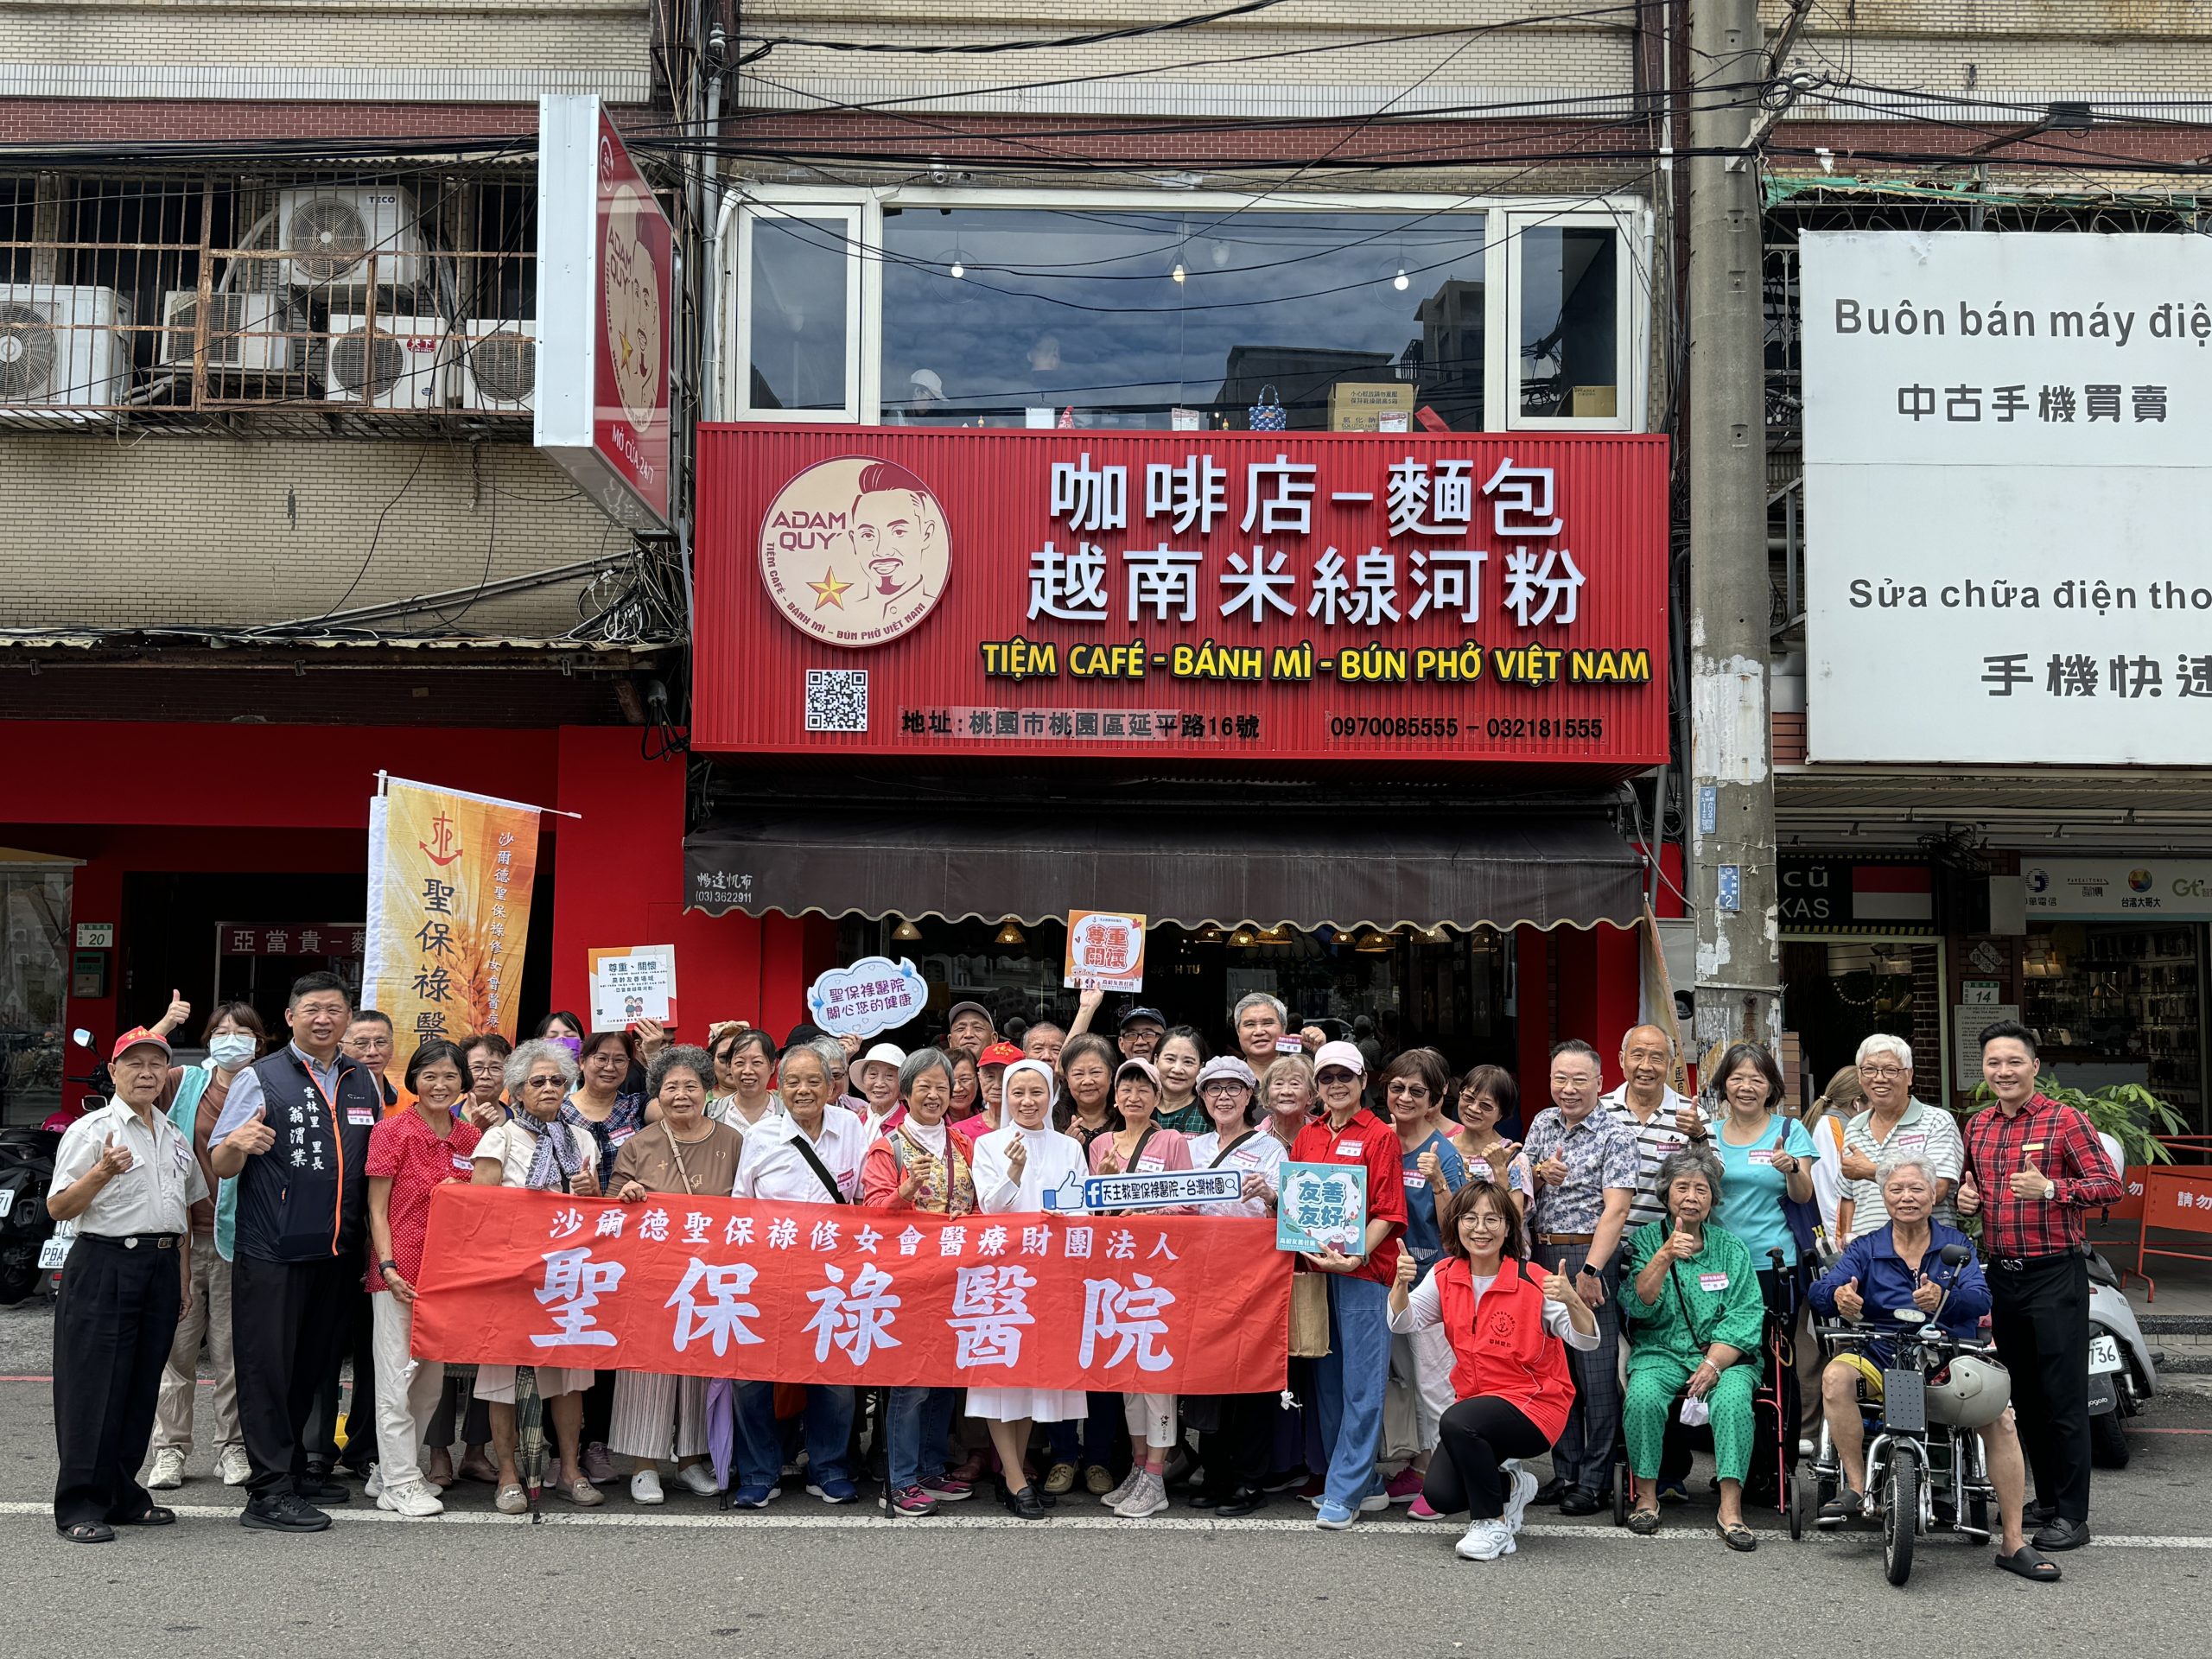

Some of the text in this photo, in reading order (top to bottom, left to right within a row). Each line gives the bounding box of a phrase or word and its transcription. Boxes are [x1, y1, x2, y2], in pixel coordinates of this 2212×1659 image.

[608, 226, 632, 276] ADAM
[1835, 298, 1946, 336] Buôn
[1960, 300, 2036, 338] bán
[2050, 302, 2135, 347] máy
[1897, 384, 2168, 423] 中古手機買賣
[771, 511, 846, 530] ADAM
[766, 543, 775, 568] TIỆM
[769, 569, 785, 595] CAFÉ
[1027, 541, 1586, 626] 越南米線河粉
[1849, 577, 1927, 608] Sửa
[1941, 578, 2040, 608] chữa
[2053, 581, 2136, 615] điện
[786, 601, 810, 626] BÁNH
[904, 602, 926, 622] NAM
[811, 621, 826, 634] MÌ
[836, 629, 857, 640] BÚN
[883, 621, 904, 636] VIỆT
[983, 638, 1057, 678] TIỆM
[1417, 641, 1483, 679] PHỞ
[1494, 647, 1561, 684] VIỆT
[1573, 651, 1649, 680] NAM
[1981, 653, 2212, 699] 手機快速
[1331, 716, 1459, 737] 0970085555
[1486, 717, 1603, 739] 032181555
[1783, 866, 1828, 887] cũ
[1726, 894, 1732, 907] 2
[88, 933, 105, 945] 20
[1086, 925, 1128, 947] 尊重
[1084, 945, 1128, 969] 關懷
[829, 977, 906, 1004] 聖保祿醫院
[1976, 990, 1991, 1003] 14
[826, 993, 912, 1021] 關心您的健康
[303, 1086, 320, 1128] 雲林里
[288, 1106, 308, 1167] 翁渭業
[1298, 1180, 1345, 1205] 友善
[1297, 1205, 1344, 1228] 友好
[550, 1207, 1180, 1262] 沙爾德聖保祿修女會醫療財團法人
[529, 1246, 1175, 1371] 聖保祿醫院
